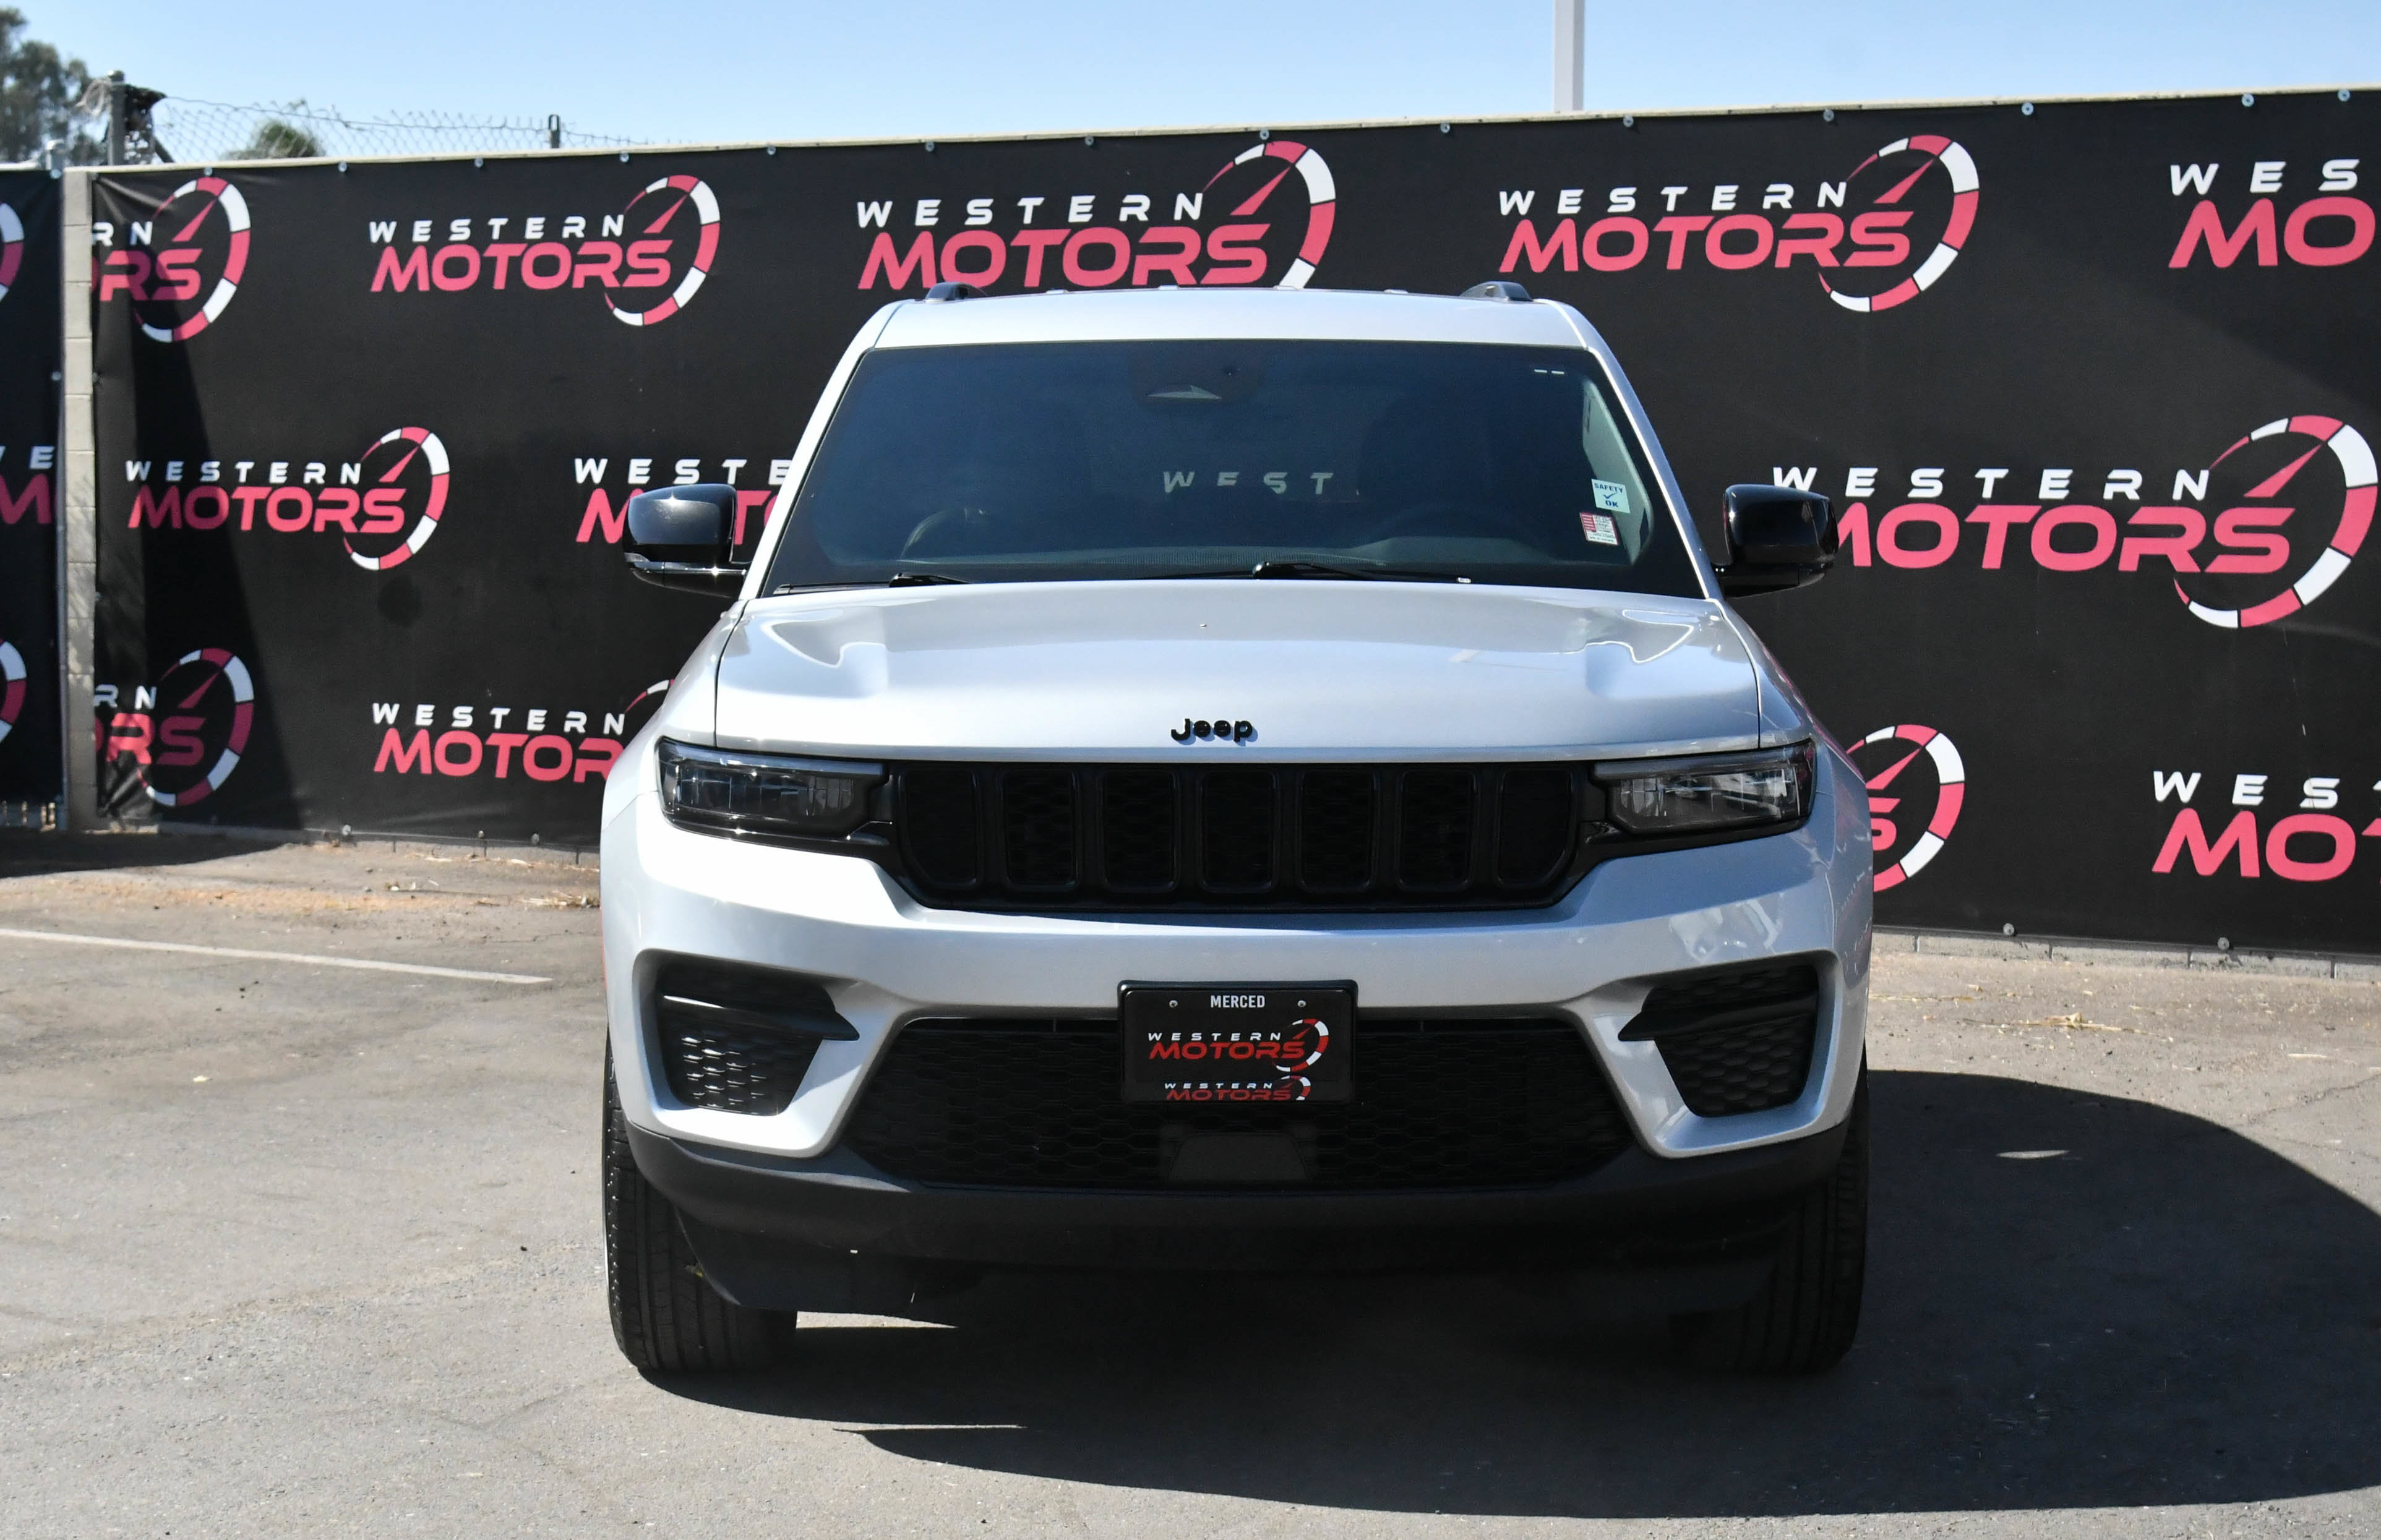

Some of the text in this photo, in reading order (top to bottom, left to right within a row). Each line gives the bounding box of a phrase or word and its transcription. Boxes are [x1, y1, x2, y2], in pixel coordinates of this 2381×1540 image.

[2170, 159, 2360, 196] WES
[857, 192, 1203, 228] WESTERN
[1499, 181, 1847, 215] WESTERN
[369, 214, 624, 243] WESTERN
[1499, 211, 1914, 273] MOTORS
[2168, 196, 2377, 268] MO
[371, 239, 673, 292] MOTORS
[857, 224, 1271, 290] MOTORS
[91, 249, 203, 302] RS
[126, 460, 362, 483] WESTERN
[1594, 483, 1623, 493] SAFETY
[1772, 466, 2210, 501] WESTERN
[127, 485, 406, 534] MOTORS
[372, 702, 625, 735] WESTERN
[1171, 718, 1253, 743] Jeep
[95, 712, 205, 766] RS
[2153, 771, 2381, 809] WES
[2151, 808, 2381, 882] MO
[1211, 995, 1266, 1008] MERCED
[1148, 1032, 1281, 1042] WESTERN
[1149, 1042, 1305, 1059] MOTORS
[1166, 1089, 1292, 1102] MOTORS
